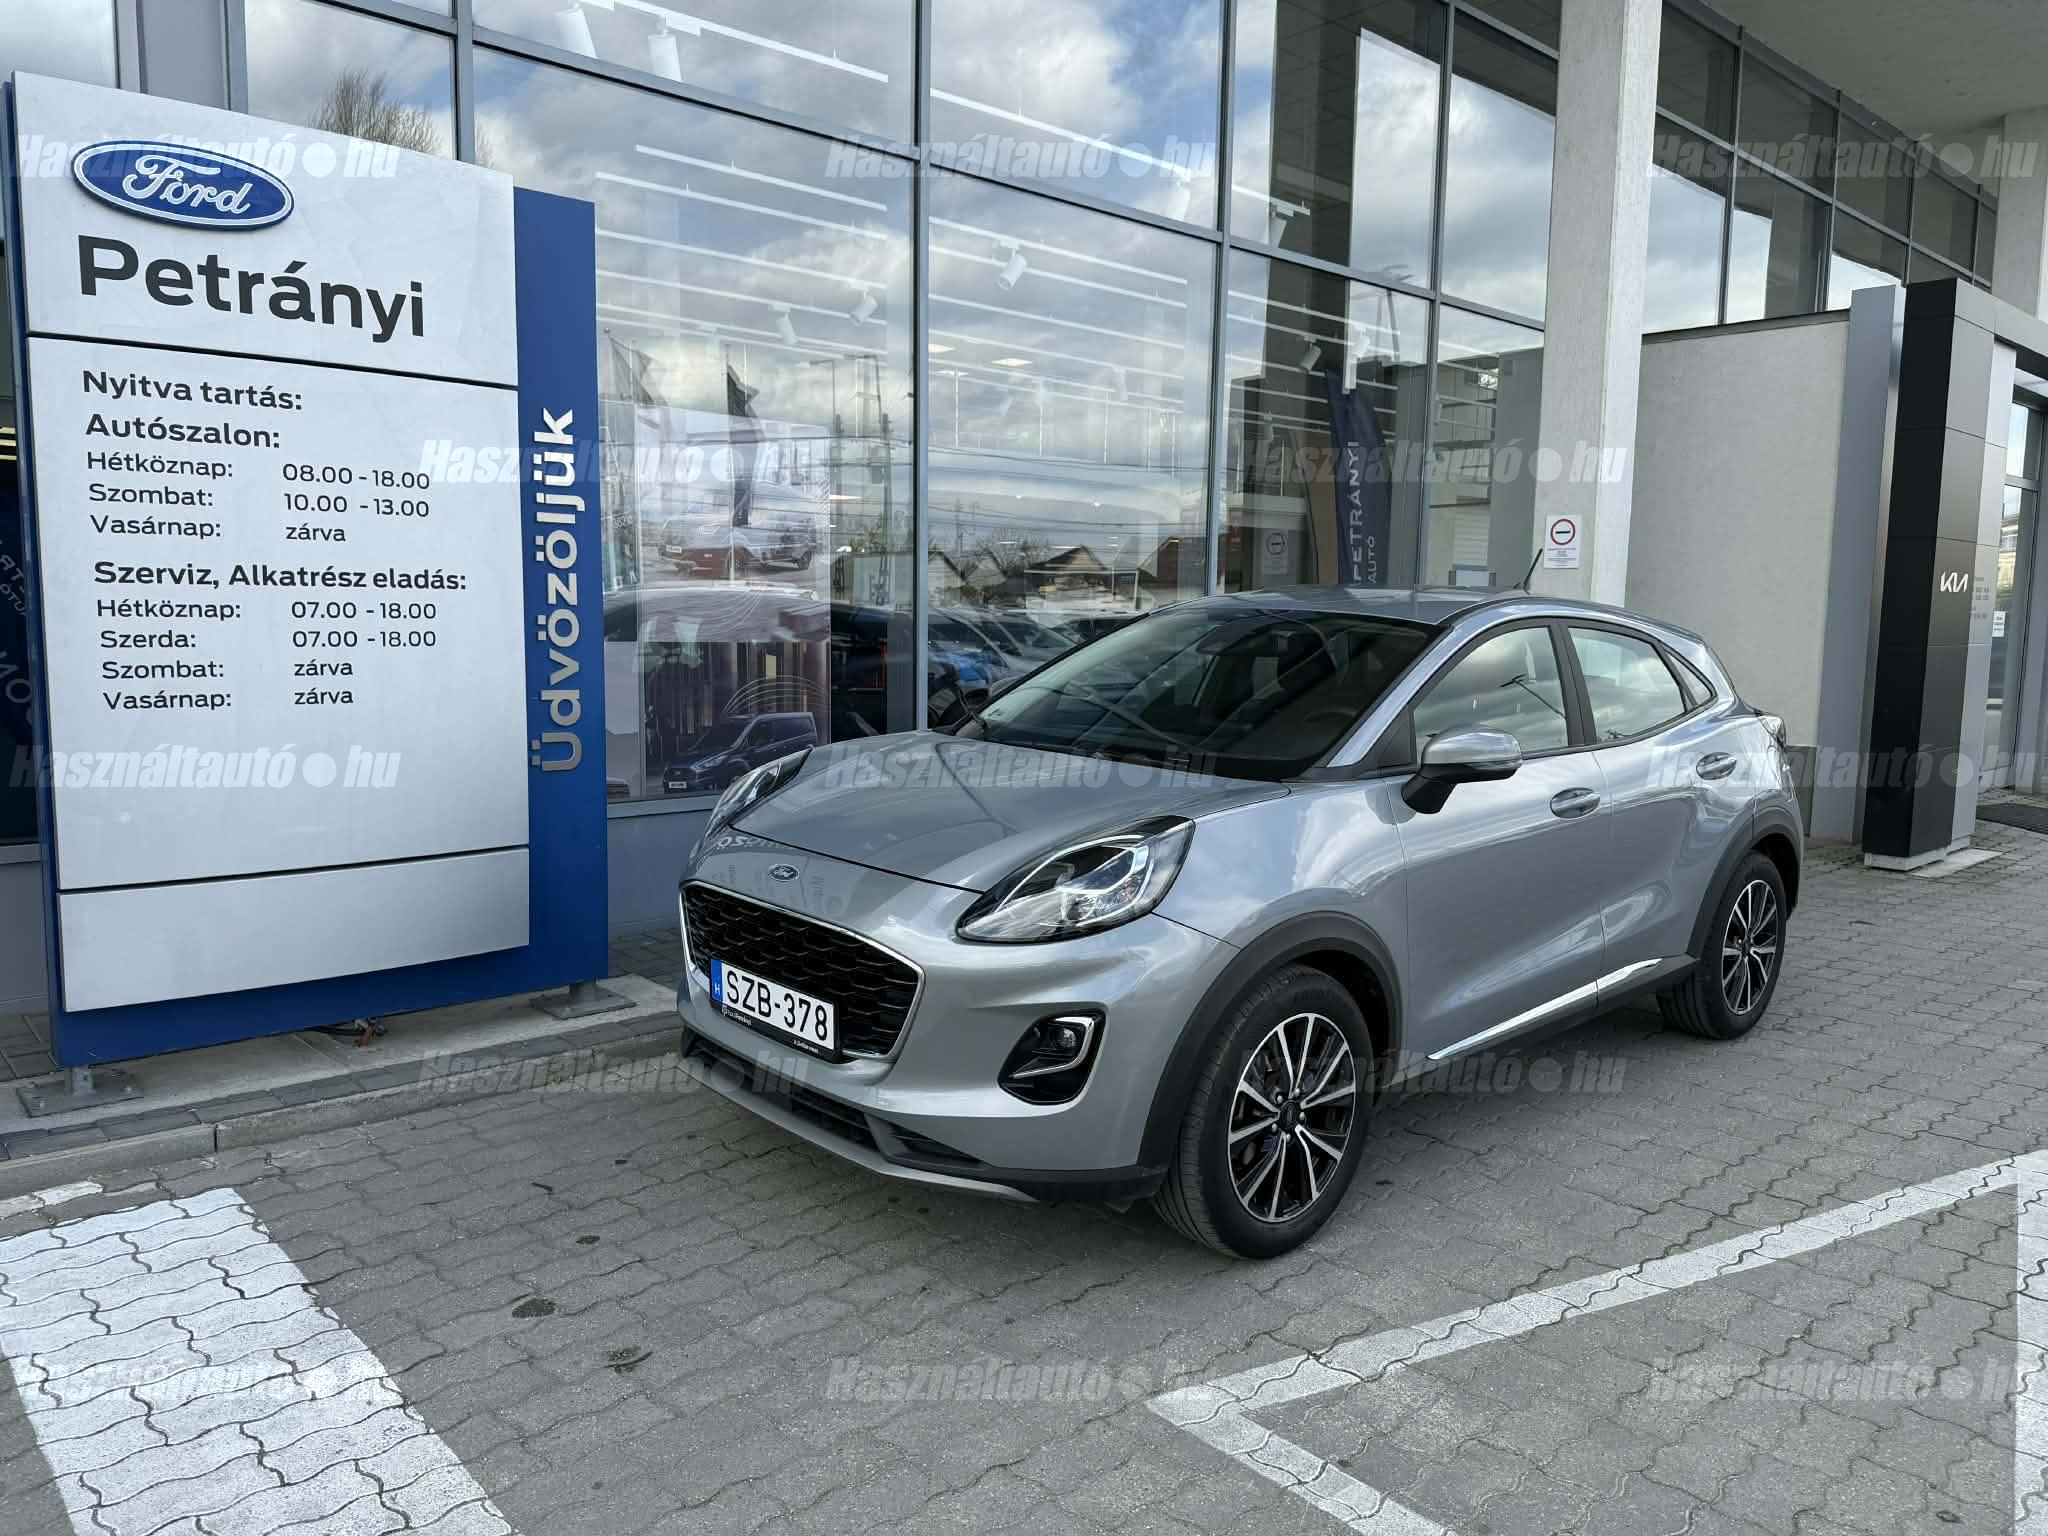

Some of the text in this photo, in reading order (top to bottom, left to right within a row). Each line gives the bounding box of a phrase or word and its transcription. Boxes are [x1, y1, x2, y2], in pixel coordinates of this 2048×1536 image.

[122, 155, 253, 214] Ford
[78, 235, 424, 343] Petrányi
[83, 370, 302, 410] Nyitva tartás:
[85, 414, 279, 448] Autószalon:
[88, 452, 232, 480] Hétköznap:
[283, 464, 352, 484] 08.00
[89, 483, 213, 506] Szombat:
[284, 493, 347, 512] 10.00
[90, 515, 346, 542] Vasárnap: zárva
[94, 561, 466, 590] Szerviz, Alkatrész eladás:
[530, 408, 586, 772] Üdvözöljük
[97, 599, 240, 621] Hétköznap:
[292, 601, 356, 618] 07.00
[101, 630, 196, 648] Szerda:
[293, 631, 357, 647] 07.00
[102, 659, 353, 679] Szombat: zárva
[103, 688, 353, 710] Vasárnap: zárva
[726, 969, 829, 1041] SZB-378
